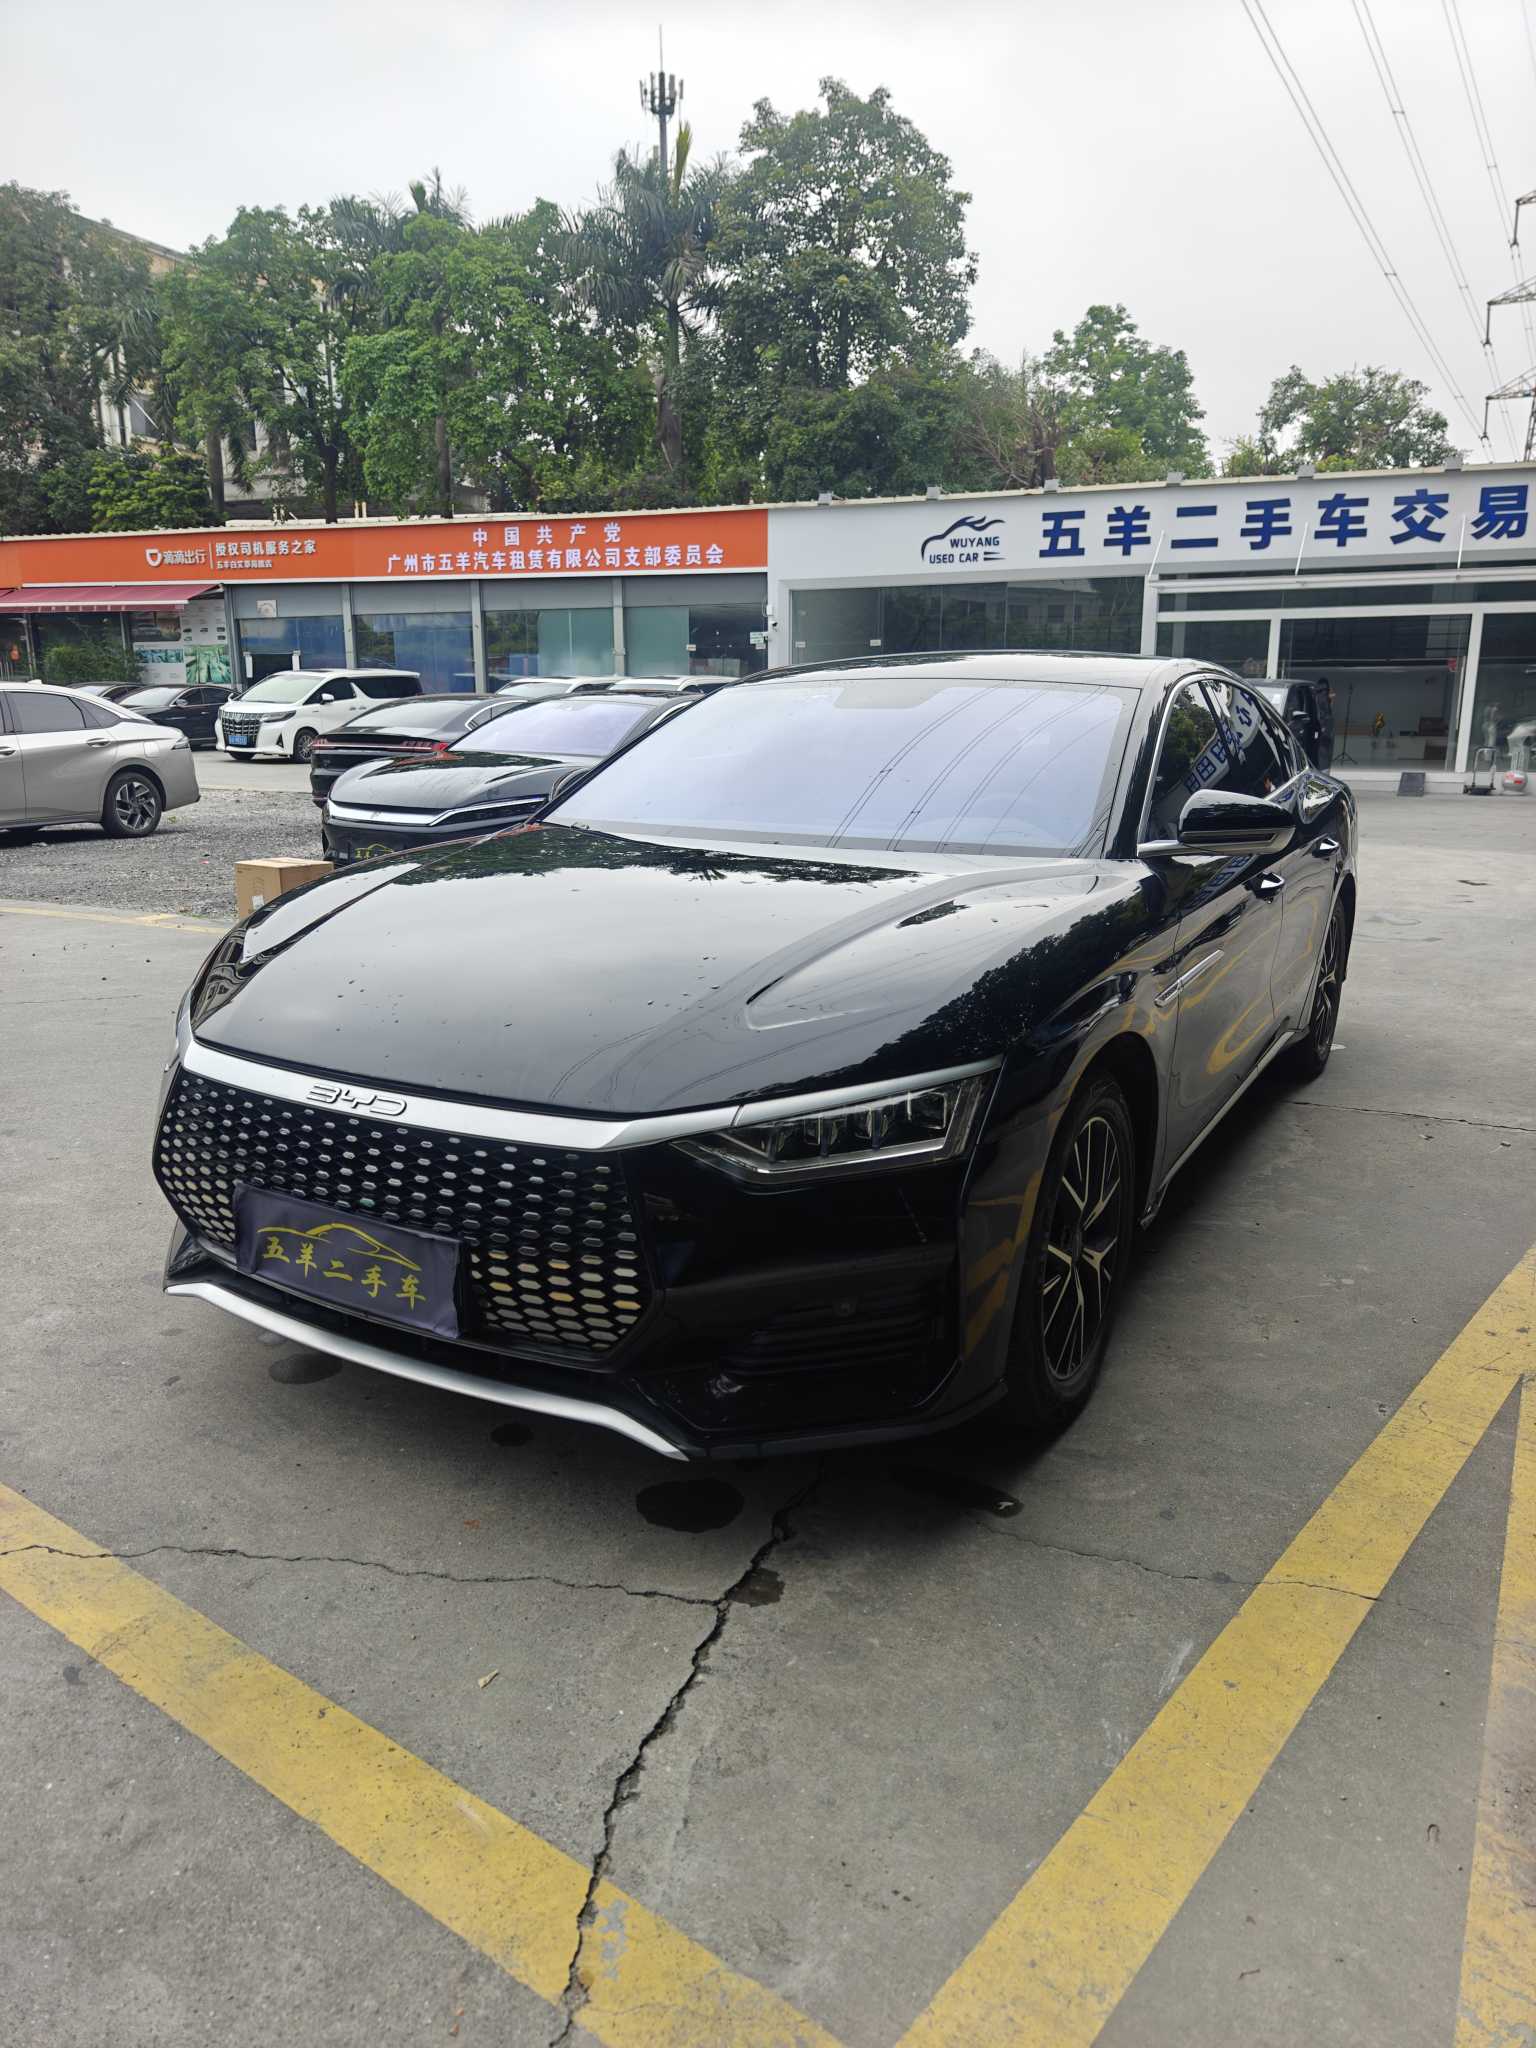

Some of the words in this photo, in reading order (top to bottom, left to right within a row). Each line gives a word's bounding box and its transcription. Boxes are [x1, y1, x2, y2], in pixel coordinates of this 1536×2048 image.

[472, 522, 623, 547] 中国共产党
[1038, 484, 1529, 558] 五羊二手车交易
[215, 539, 317, 557] 授权司机服务之家
[950, 536, 1000, 548] WUYANG
[387, 543, 725, 573] 广州市五羊汽车租赁有限公司支部委员会
[929, 553, 954, 564] USED
[959, 552, 979, 563] CAR
[306, 1083, 407, 1116] BYD
[263, 1236, 427, 1312] 五羊二手车
